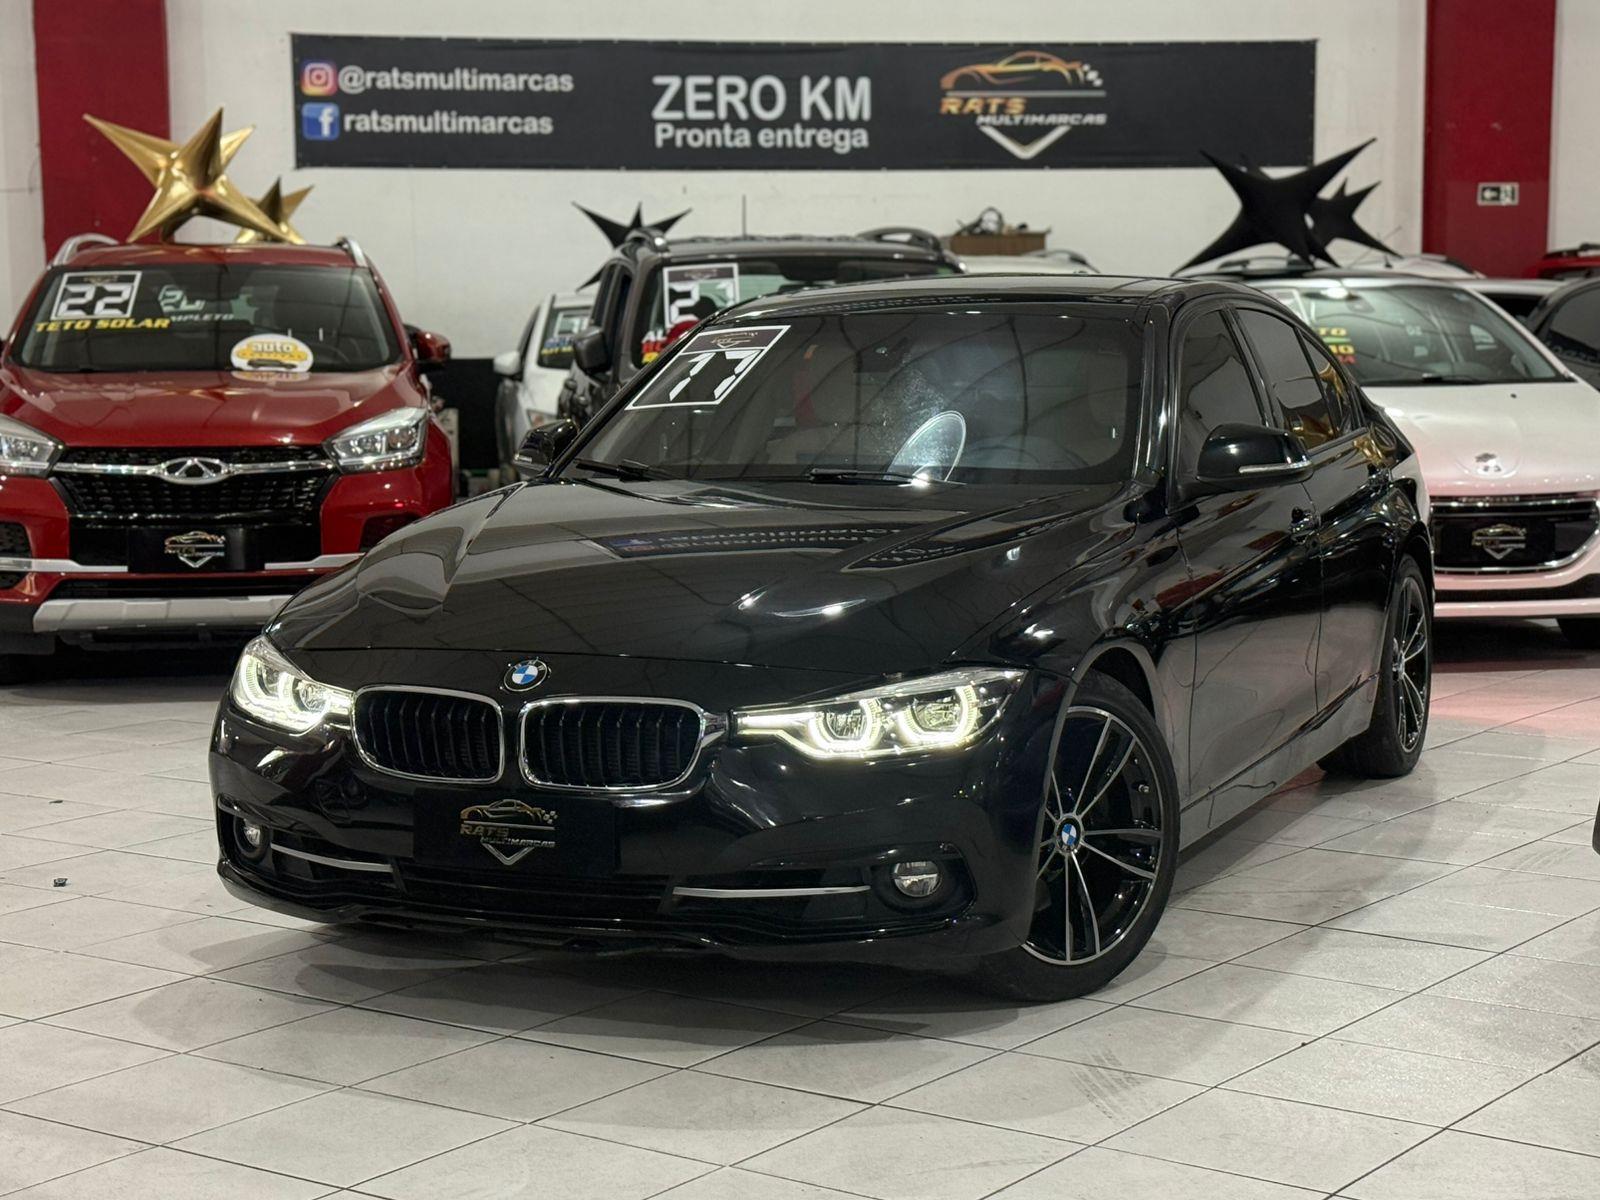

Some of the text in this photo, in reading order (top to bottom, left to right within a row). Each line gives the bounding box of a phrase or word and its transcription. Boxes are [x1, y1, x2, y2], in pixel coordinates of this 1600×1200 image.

[338, 65, 575, 95] @ratsmultimarcas
[651, 74, 872, 121] ZERO KM
[940, 96, 1028, 114] RATS
[343, 110, 554, 135] ratsmultimarcas
[975, 113, 1108, 126] MULTIMARCAS
[655, 122, 869, 154] Pronta entrega
[57, 283, 134, 316] 22
[35, 317, 171, 333] TETO SOLAR
[668, 350, 761, 402] 17
